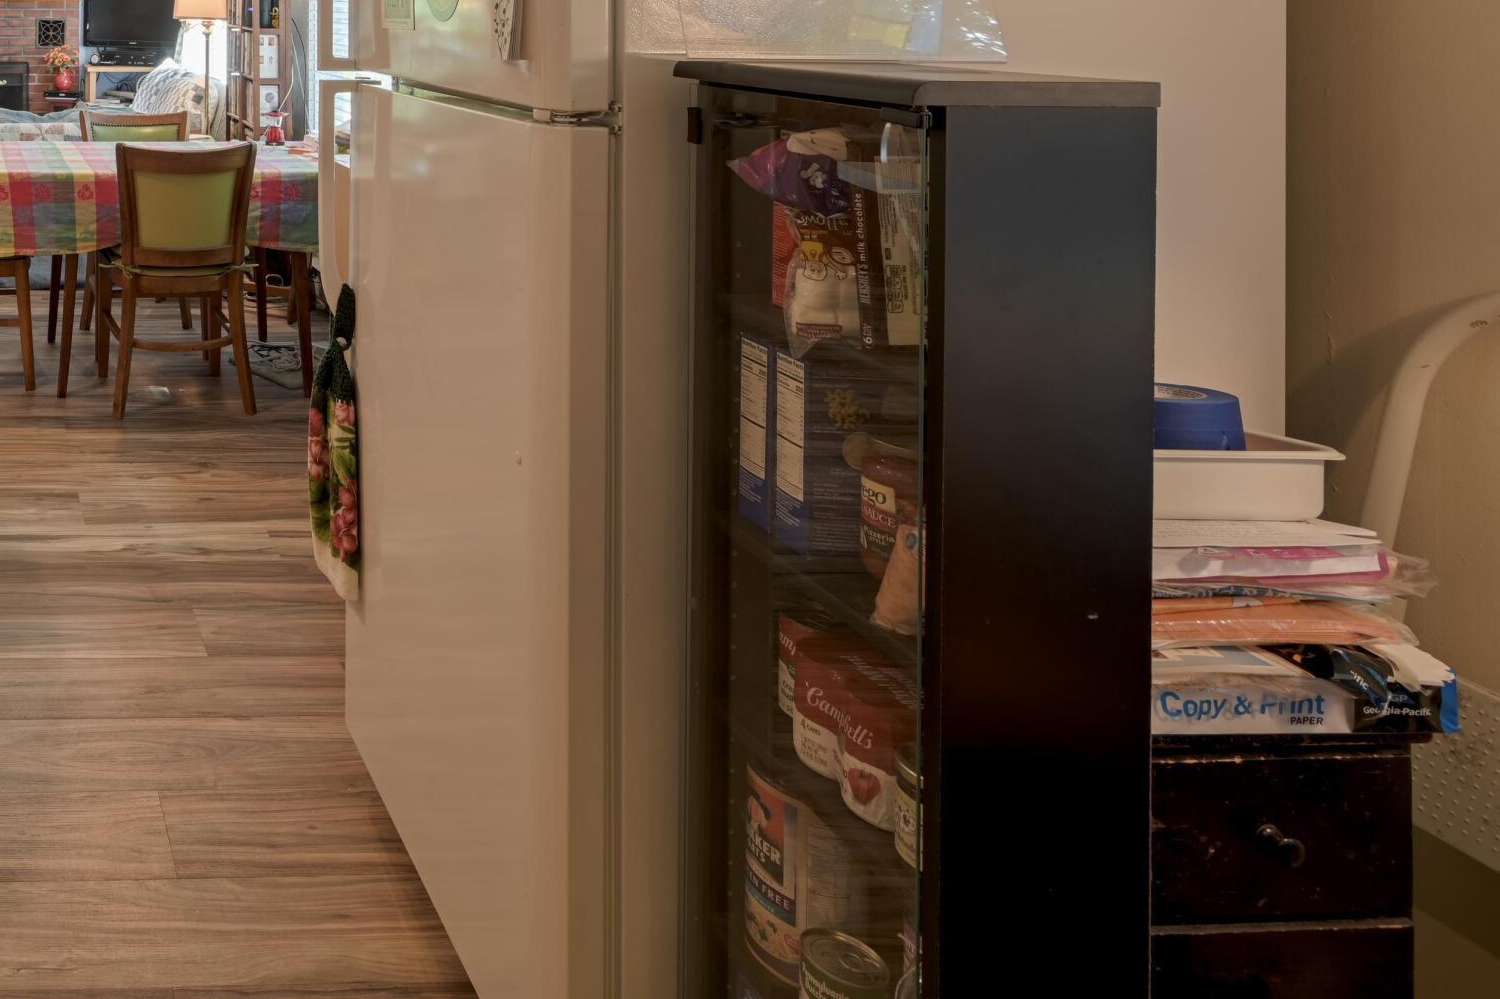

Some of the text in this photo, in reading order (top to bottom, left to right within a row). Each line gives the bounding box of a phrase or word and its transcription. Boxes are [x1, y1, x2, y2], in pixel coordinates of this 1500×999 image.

[854, 193, 864, 239] chocolate
[856, 242, 865, 262] milk
[857, 264, 871, 304] HERSHEY'S
[862, 484, 887, 506] ego
[806, 681, 874, 750] Campbell's
[1159, 691, 1325, 720] Copy & Print
[1290, 716, 1324, 725] PAPER
[761, 882, 790, 911] FREE
